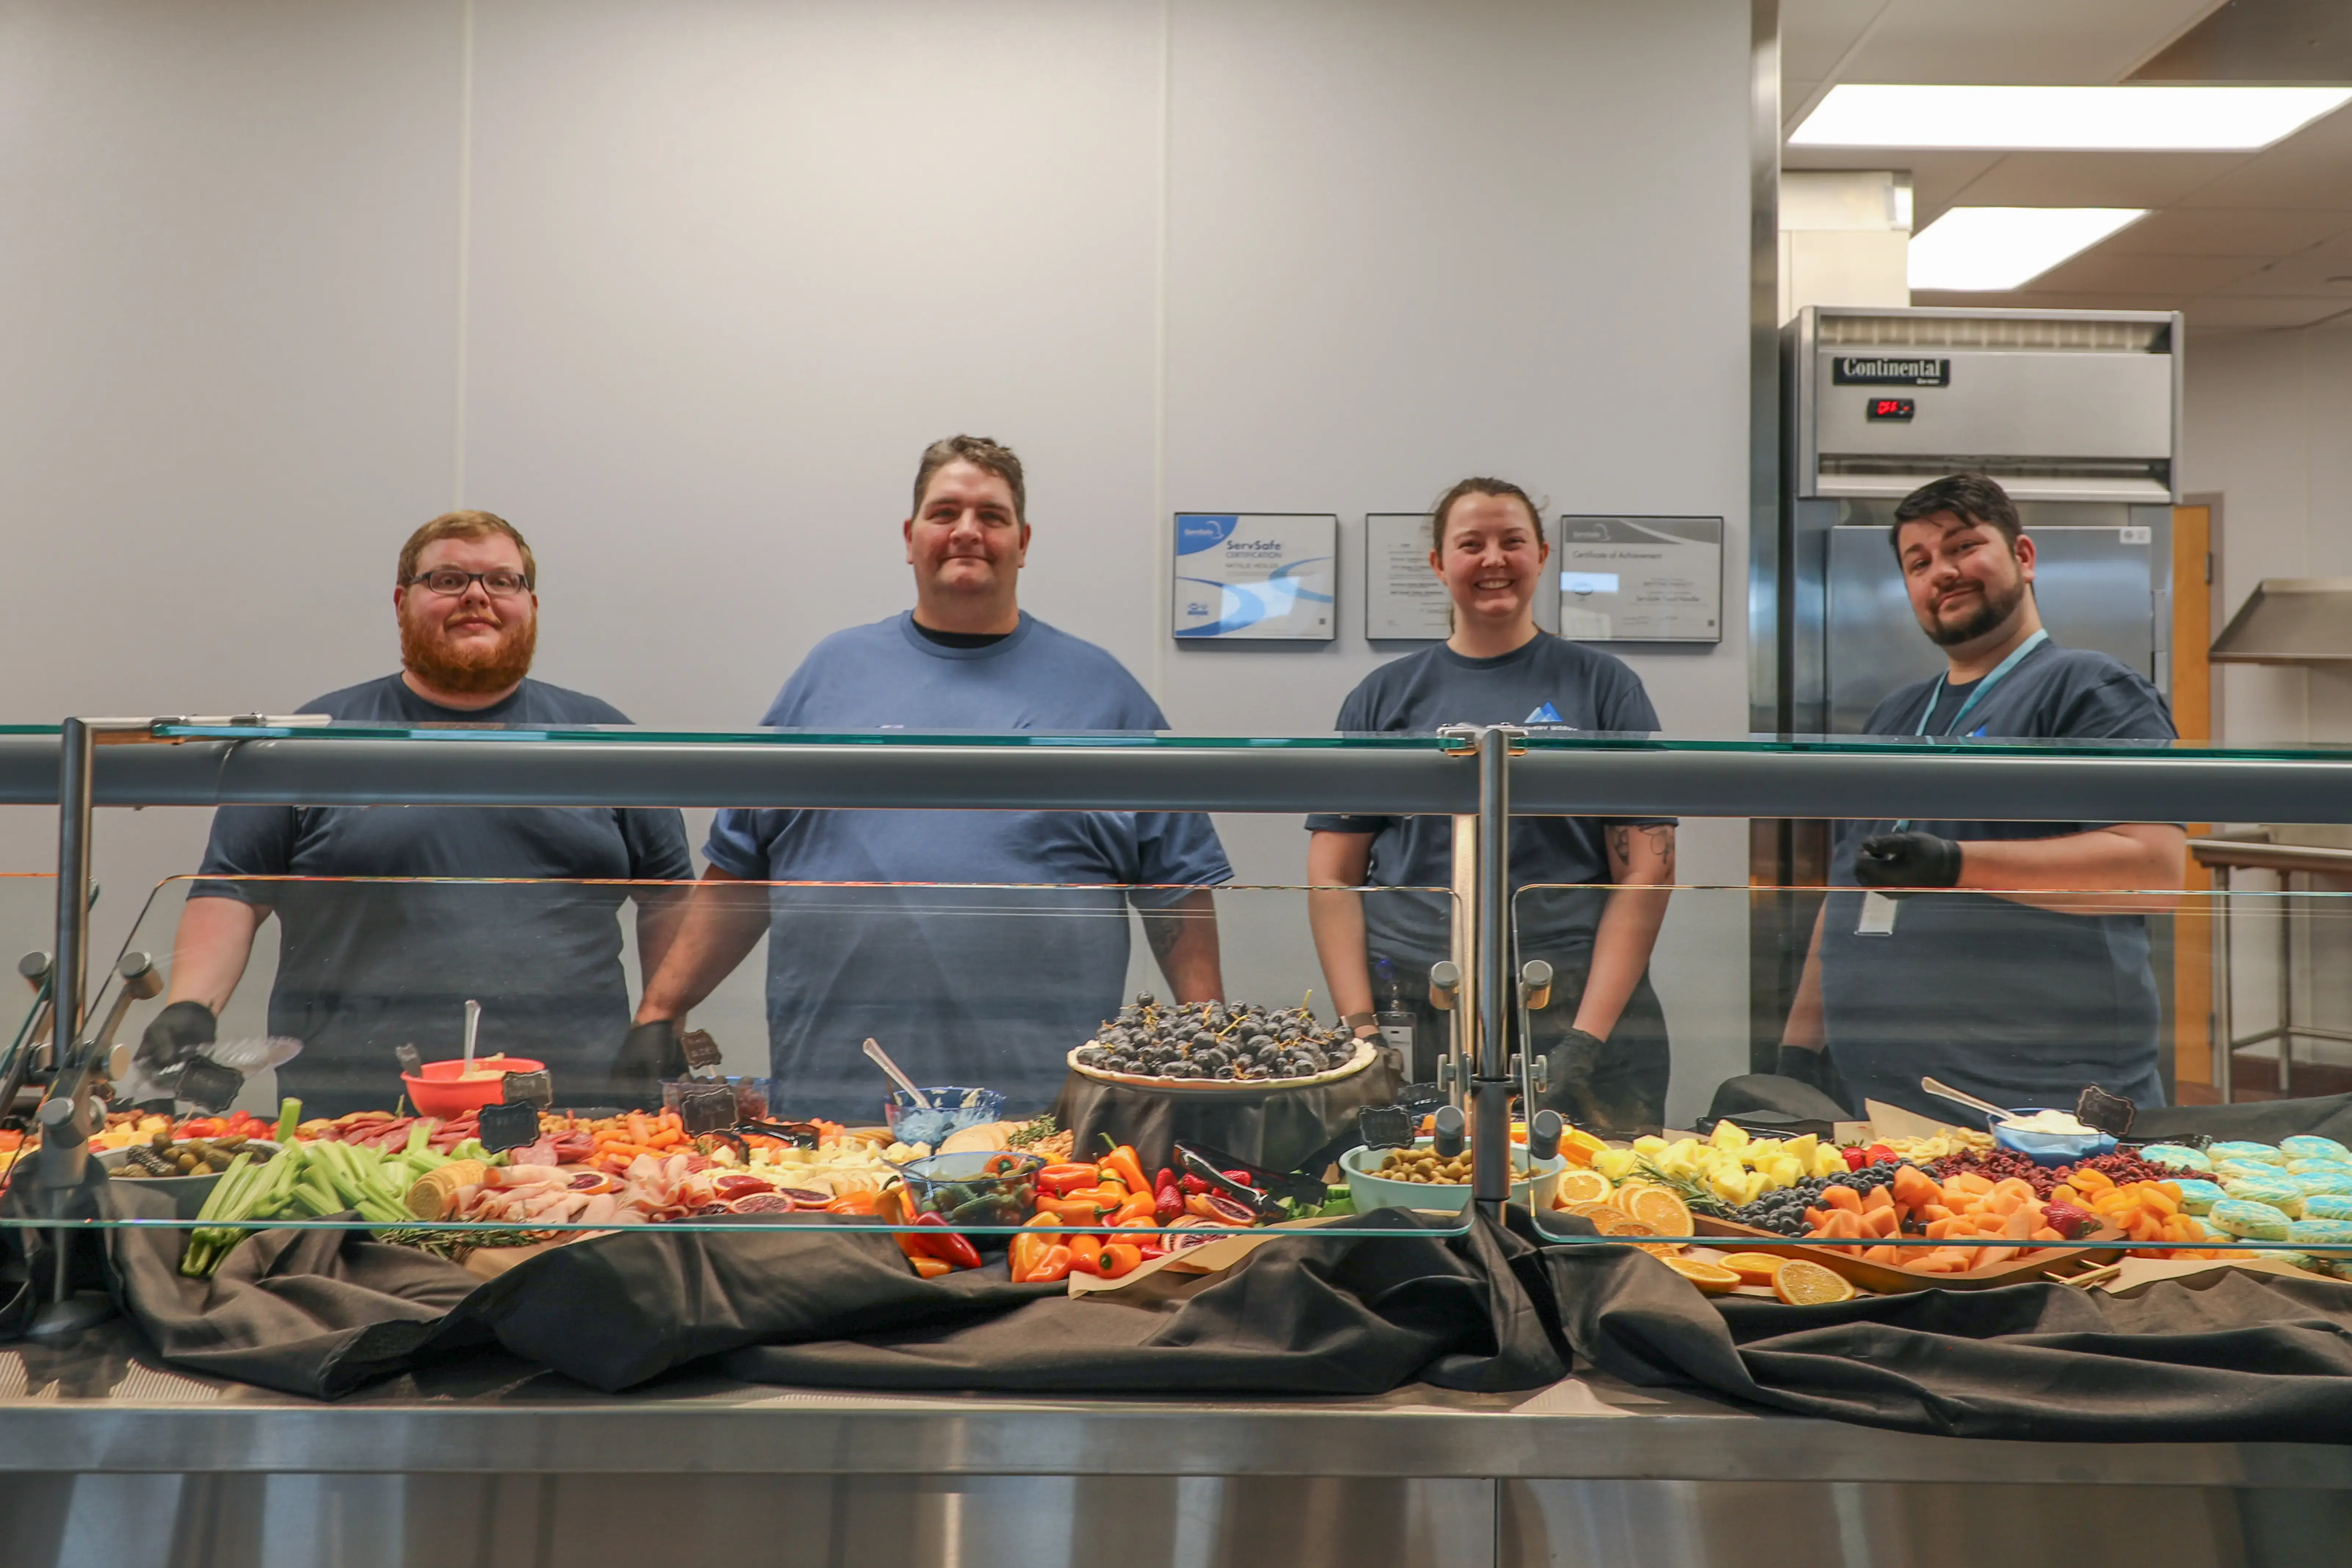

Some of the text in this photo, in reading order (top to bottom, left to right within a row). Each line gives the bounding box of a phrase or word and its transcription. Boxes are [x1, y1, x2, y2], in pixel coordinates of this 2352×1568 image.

[1843, 358, 1941, 377] Continental
[1227, 540, 1282, 550] ServSafe
[1573, 550, 1607, 558] Certificate
[1609, 550, 1616, 558] of
